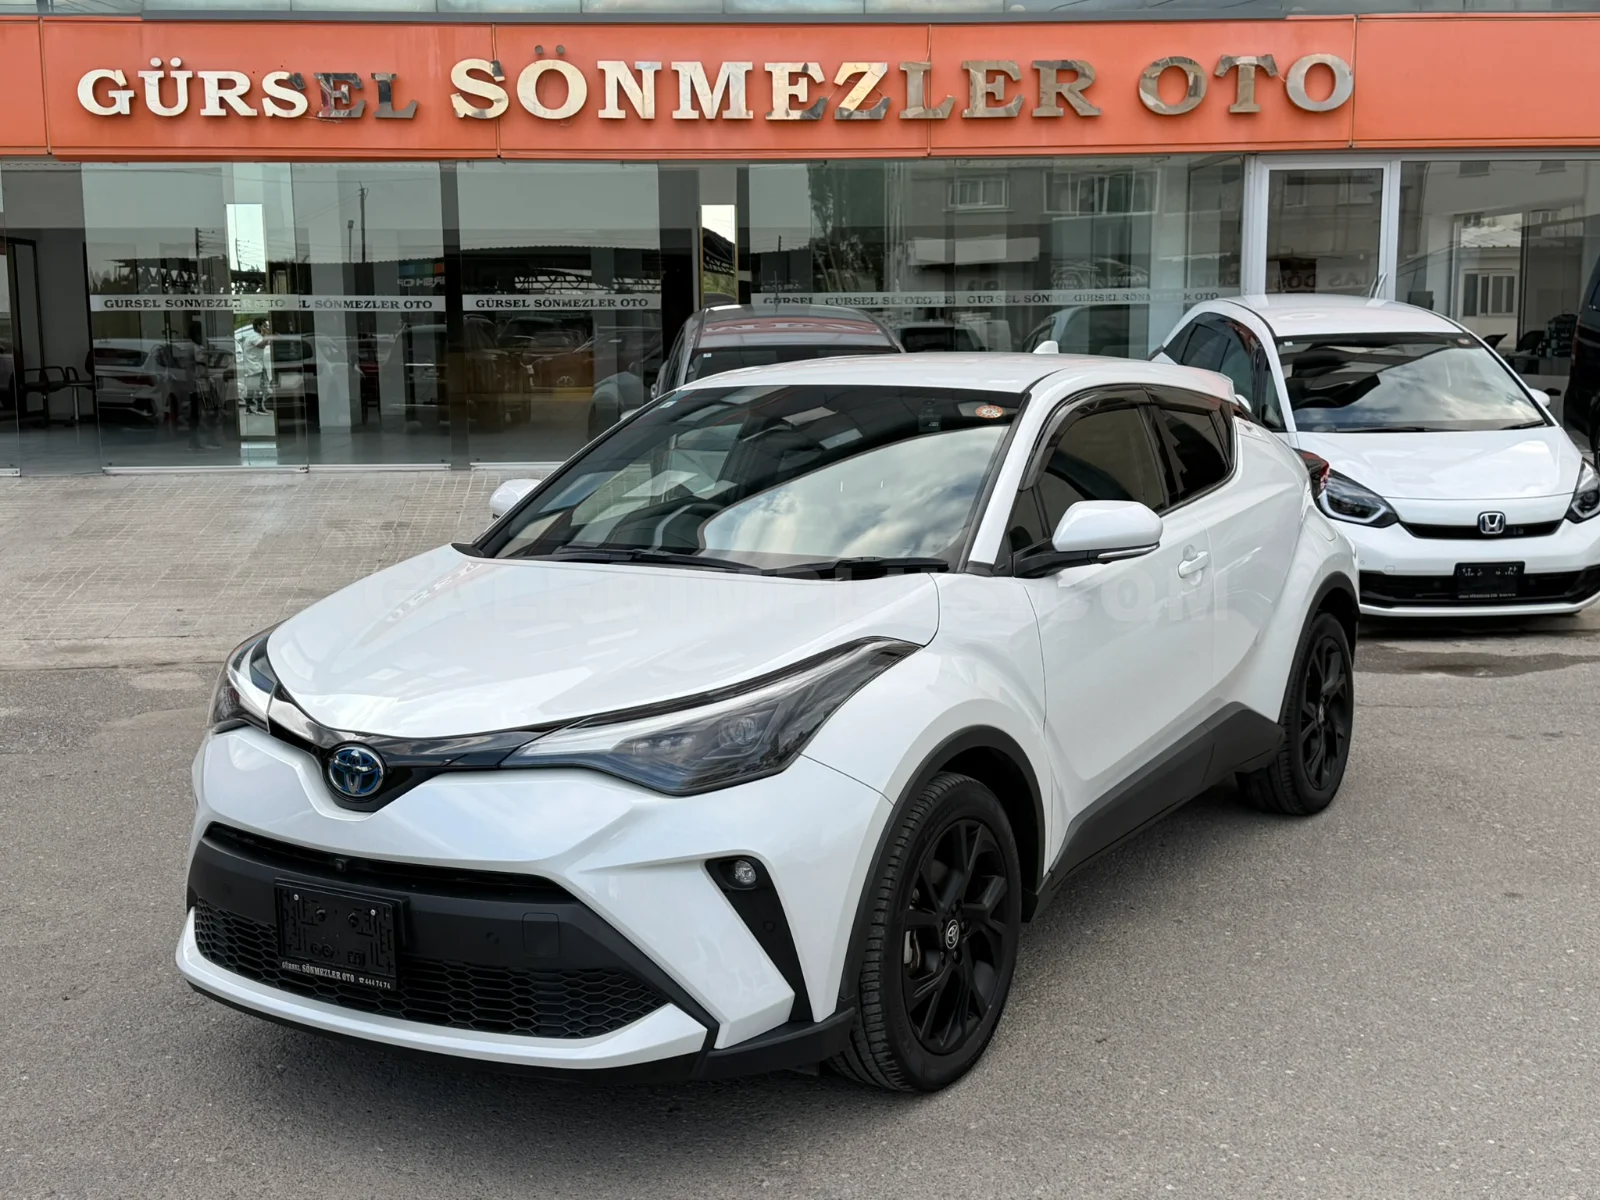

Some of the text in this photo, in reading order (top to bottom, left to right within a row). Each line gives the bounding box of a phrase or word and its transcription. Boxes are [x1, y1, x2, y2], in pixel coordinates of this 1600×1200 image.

[77, 45, 1354, 120] GÜRSEL SÖNMEZLER OTO
[315, 298, 400, 309] SÖNMEZLER
[404, 300, 433, 309] OTO
[475, 297, 648, 308] GÜRSEL SÖNMEZLER OTO
[342, 972, 355, 983] OTO
